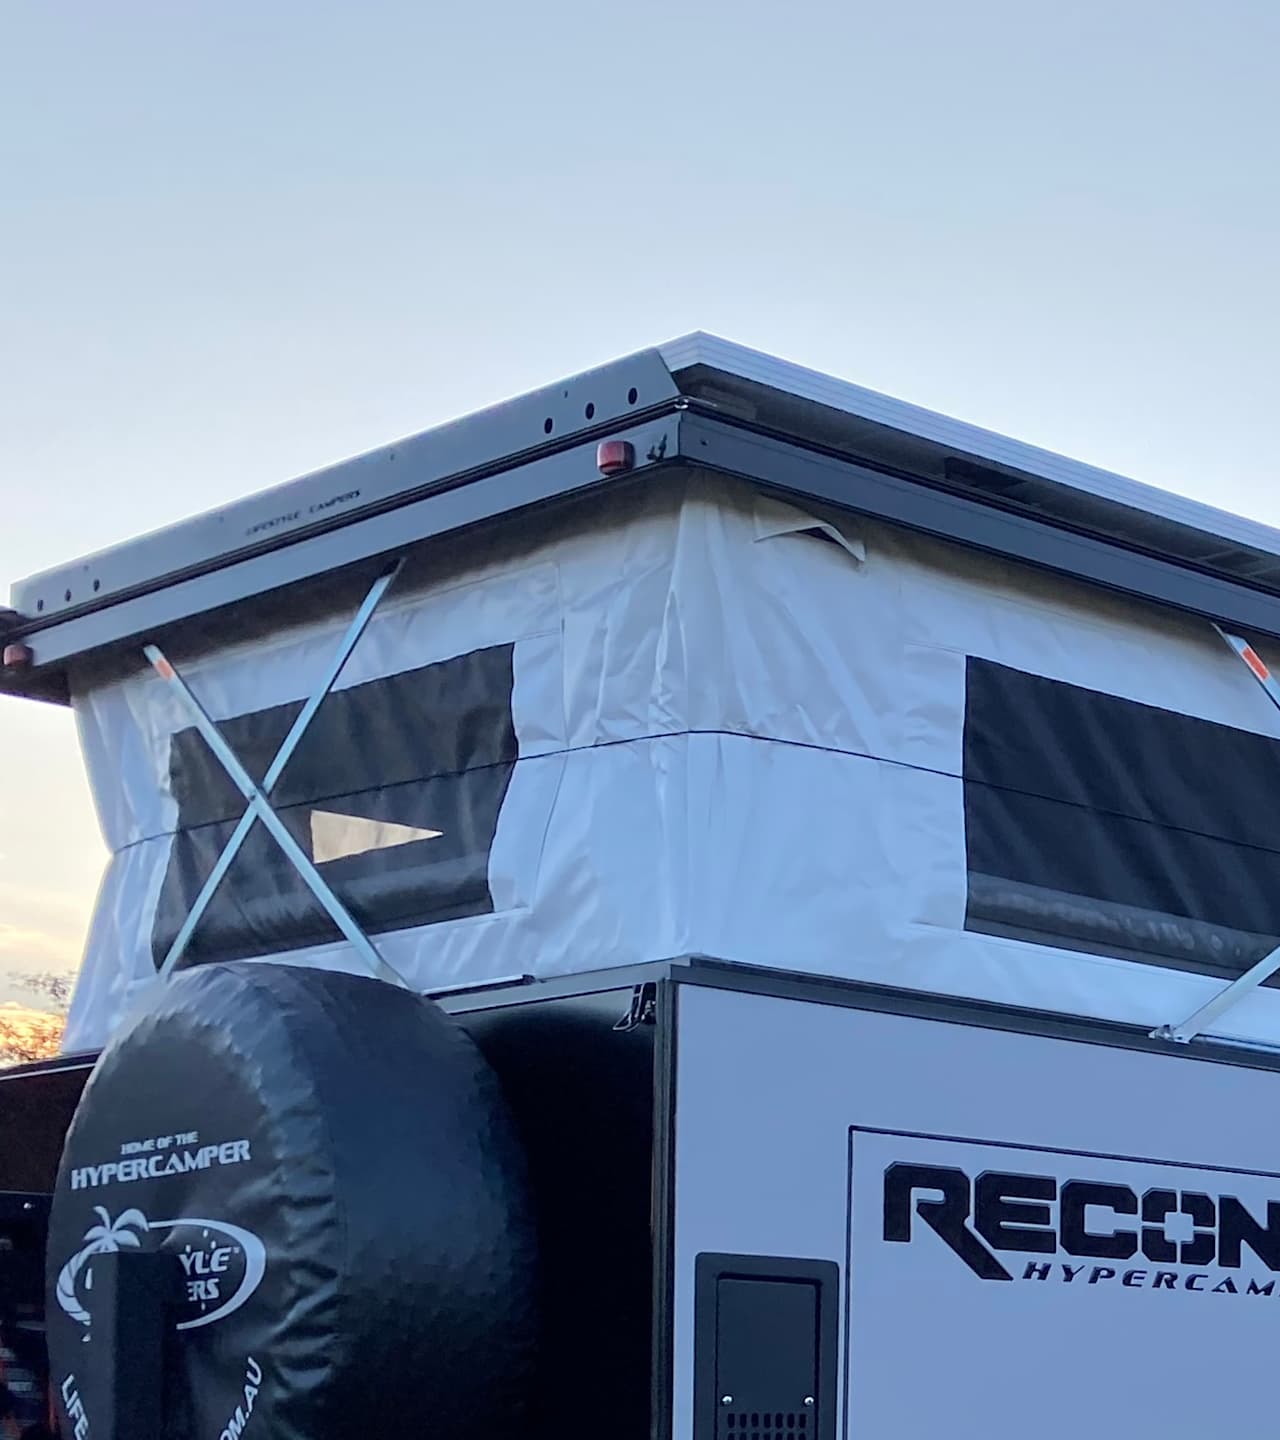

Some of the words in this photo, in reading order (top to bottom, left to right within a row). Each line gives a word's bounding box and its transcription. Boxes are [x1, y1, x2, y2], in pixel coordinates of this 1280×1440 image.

[120, 1138, 155, 1155] HOME
[156, 1134, 175, 1150] OF
[175, 1130, 199, 1146] THE
[70, 1139, 252, 1190] HYPERCAMPER
